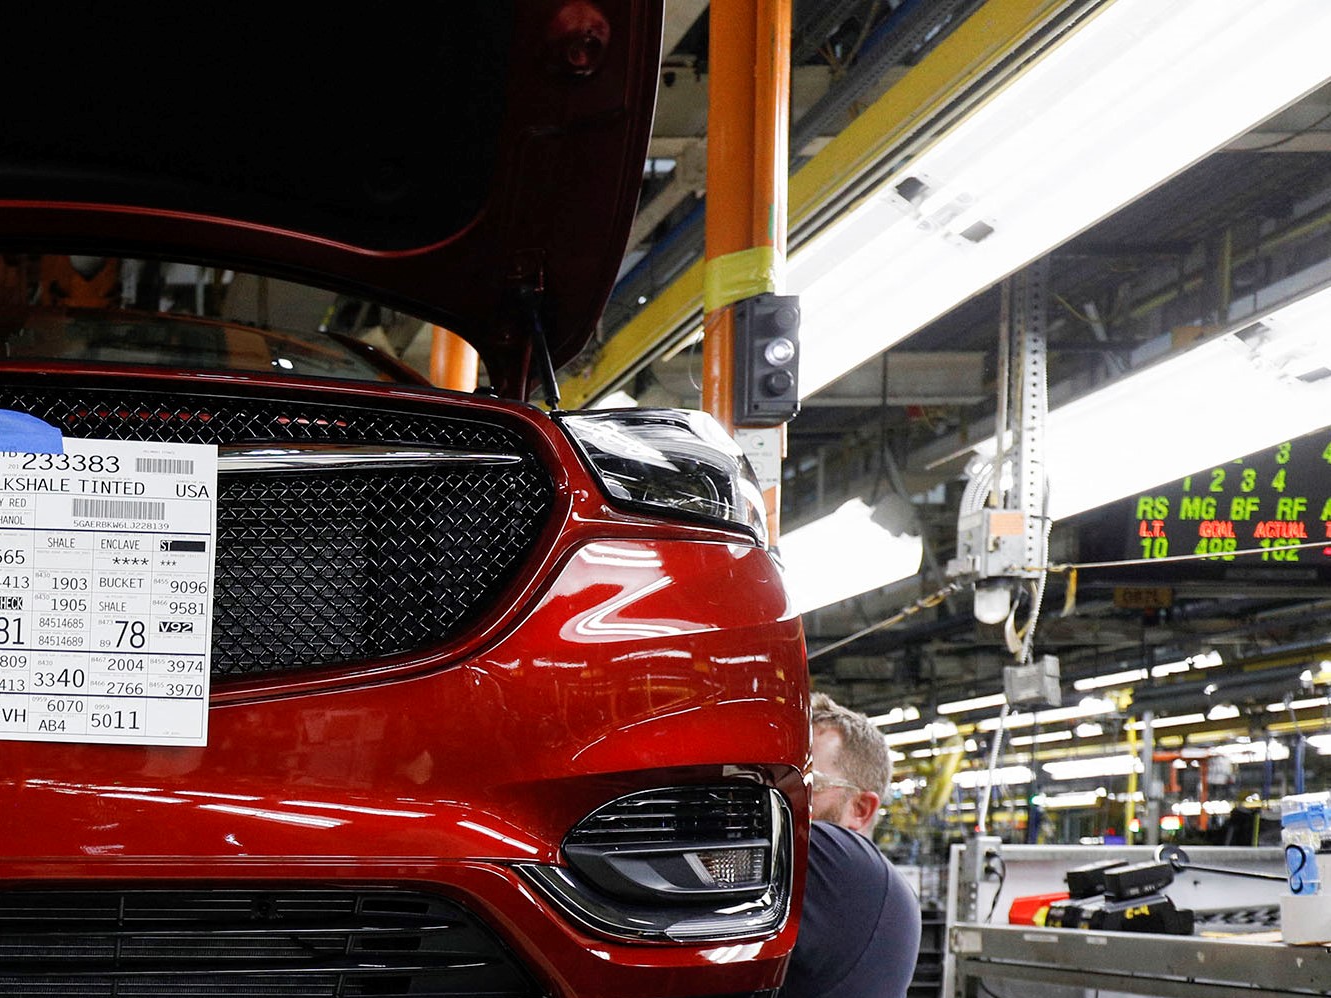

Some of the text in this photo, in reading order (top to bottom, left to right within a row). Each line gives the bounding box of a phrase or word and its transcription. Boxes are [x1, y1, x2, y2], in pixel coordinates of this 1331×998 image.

[22, 453, 120, 473] 233383
[1209, 468, 1226, 492] 2
[1240, 468, 1257, 492] 3
[1271, 468, 1286, 492] 4
[78, 479, 145, 495] TINTED
[176, 484, 209, 498] USA
[9, 498, 26, 507] RED
[1136, 496, 1169, 520] RS
[1178, 496, 1217, 520] MG
[1230, 497, 1260, 520] BF
[1276, 497, 1308, 520] RF
[1198, 520, 1236, 538] GOAL
[1253, 521, 1308, 538] ACTUAL
[47, 537, 75, 548] SHALE
[101, 539, 140, 549] ENCLAVE
[160, 541, 172, 551] ST
[1140, 537, 1169, 559] 10
[52, 577, 87, 590] 1903
[99, 577, 144, 588] BUCKET
[170, 580, 207, 594] 9096
[51, 599, 87, 611] 1905
[99, 601, 126, 612] SHALE
[169, 602, 205, 615] 9581
[39, 618, 84, 628] 84514685
[160, 622, 193, 633] V92
[115, 621, 145, 648] 78
[38, 636, 83, 647] 84514689
[107, 659, 144, 671] 2004
[167, 660, 202, 673] 3974
[34, 668, 84, 688] 3340
[106, 682, 143, 695] 2766
[166, 684, 202, 696] 3970
[47, 700, 83, 712] 6070
[38, 720, 66, 731] AB4
[91, 711, 139, 729] 5011
